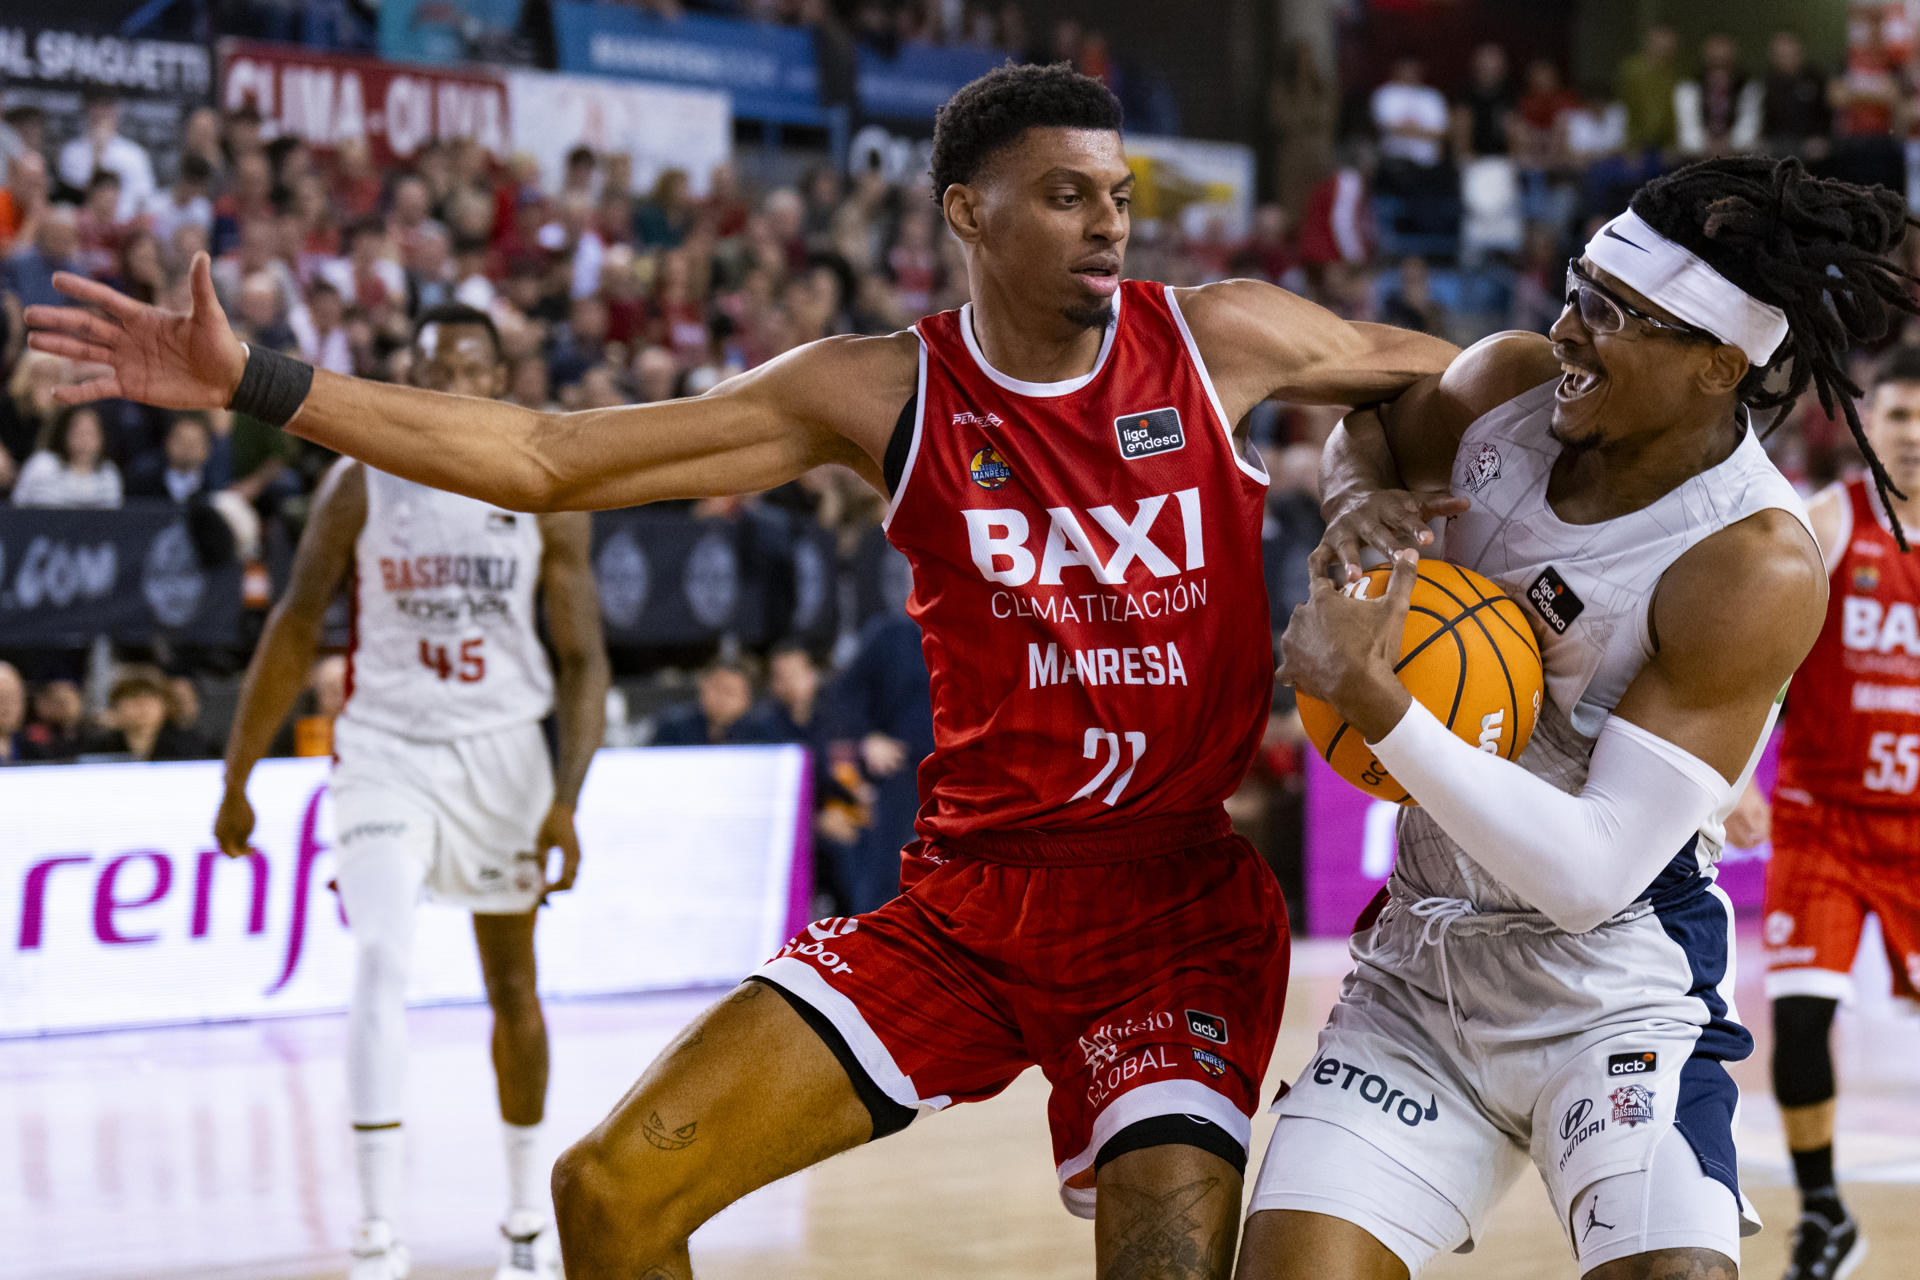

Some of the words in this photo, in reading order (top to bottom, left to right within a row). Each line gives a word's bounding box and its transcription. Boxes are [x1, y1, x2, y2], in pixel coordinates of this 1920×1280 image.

[1123, 428, 1149, 442] liga
[1126, 433, 1180, 453] endesa
[972, 467, 1011, 480] MANRESA
[960, 487, 1206, 587] BAXI
[1531, 588, 1566, 631] endesa
[1538, 577, 1556, 601] liga
[1842, 595, 1920, 657] BA
[417, 636, 487, 684] 45
[1028, 641, 1188, 690] MANRESA
[1361, 753, 1390, 786] ac
[1863, 731, 1920, 795] 55
[17, 782, 347, 998] renf
[1192, 1020, 1218, 1038] acb
[1087, 1045, 1178, 1108] GLOBAL
[1611, 1060, 1647, 1074] acb
